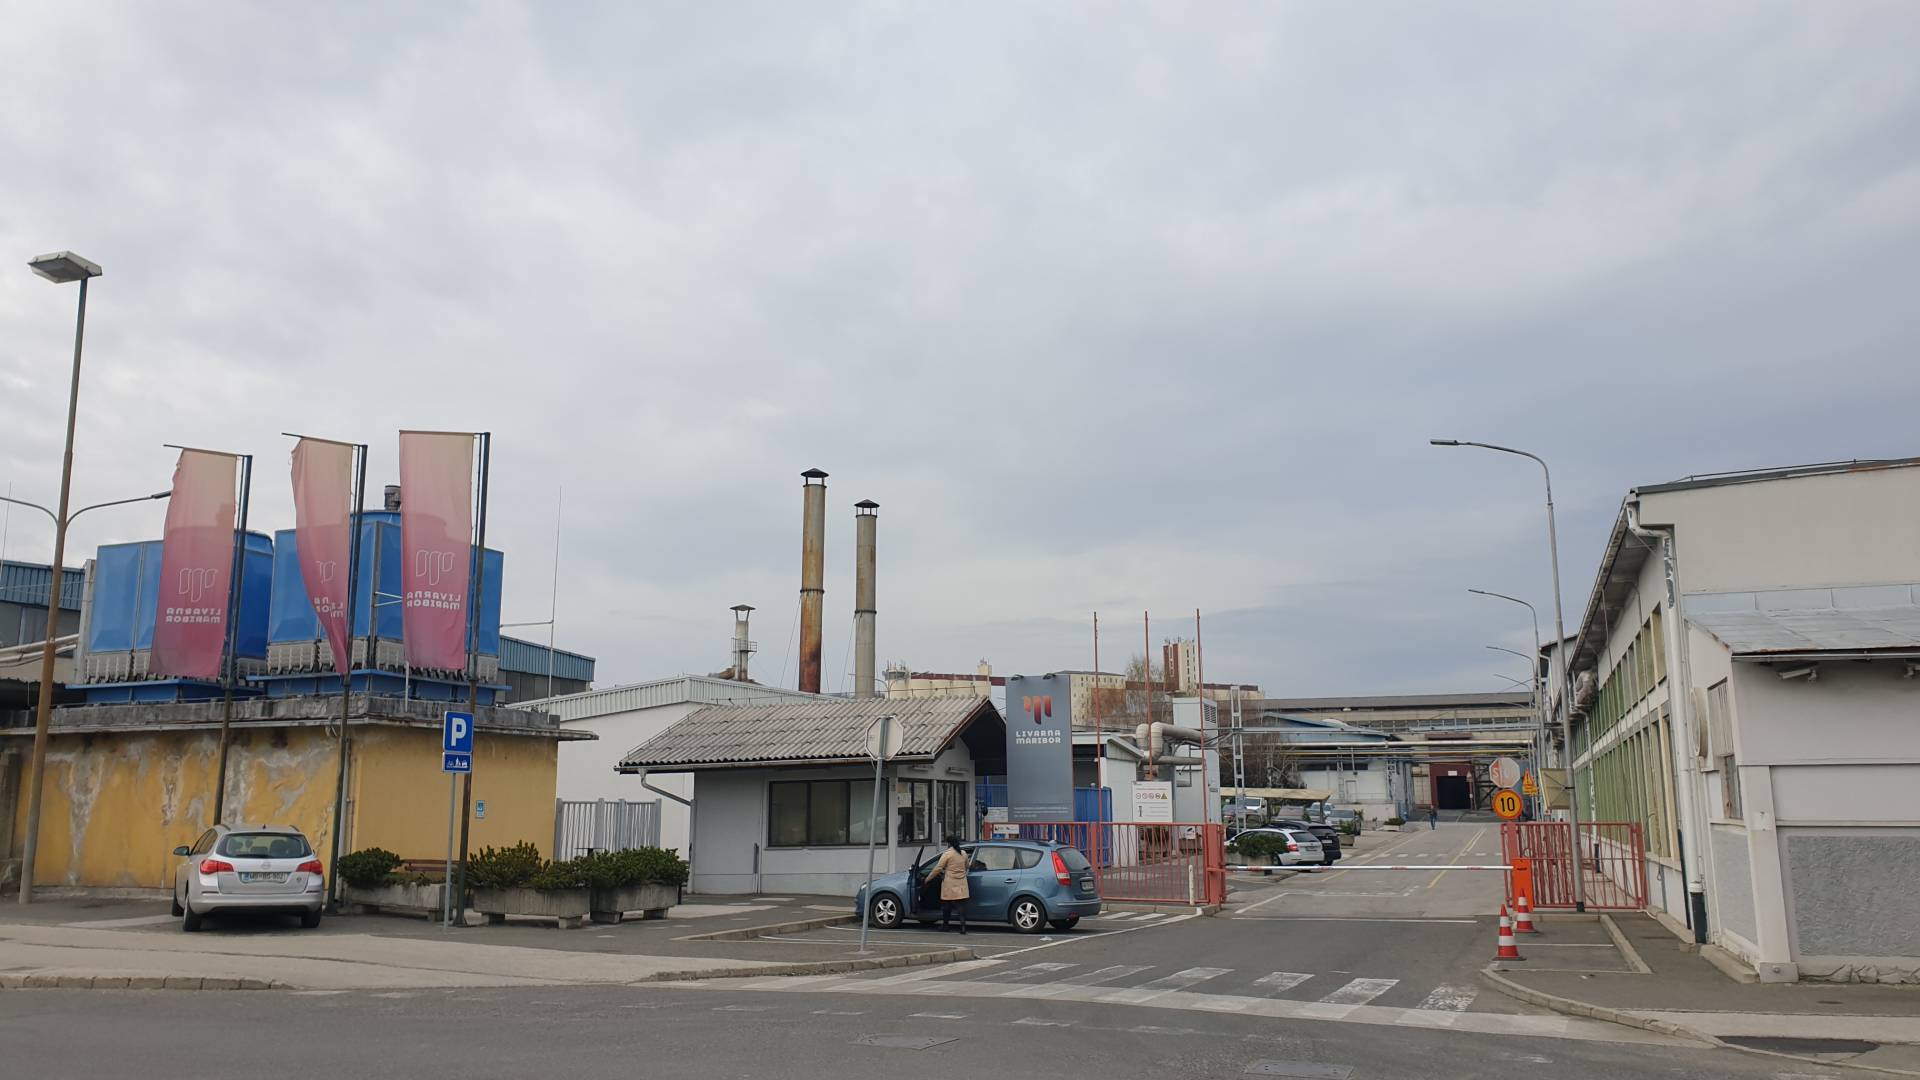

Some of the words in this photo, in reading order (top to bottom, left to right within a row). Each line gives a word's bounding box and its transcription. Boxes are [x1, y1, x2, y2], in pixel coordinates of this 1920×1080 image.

[450, 717, 467, 747] P
[1015, 729, 1061, 738] LIVARNA
[1015, 737, 1062, 745] MARIBOR
[1500, 796, 1516, 813] 10
